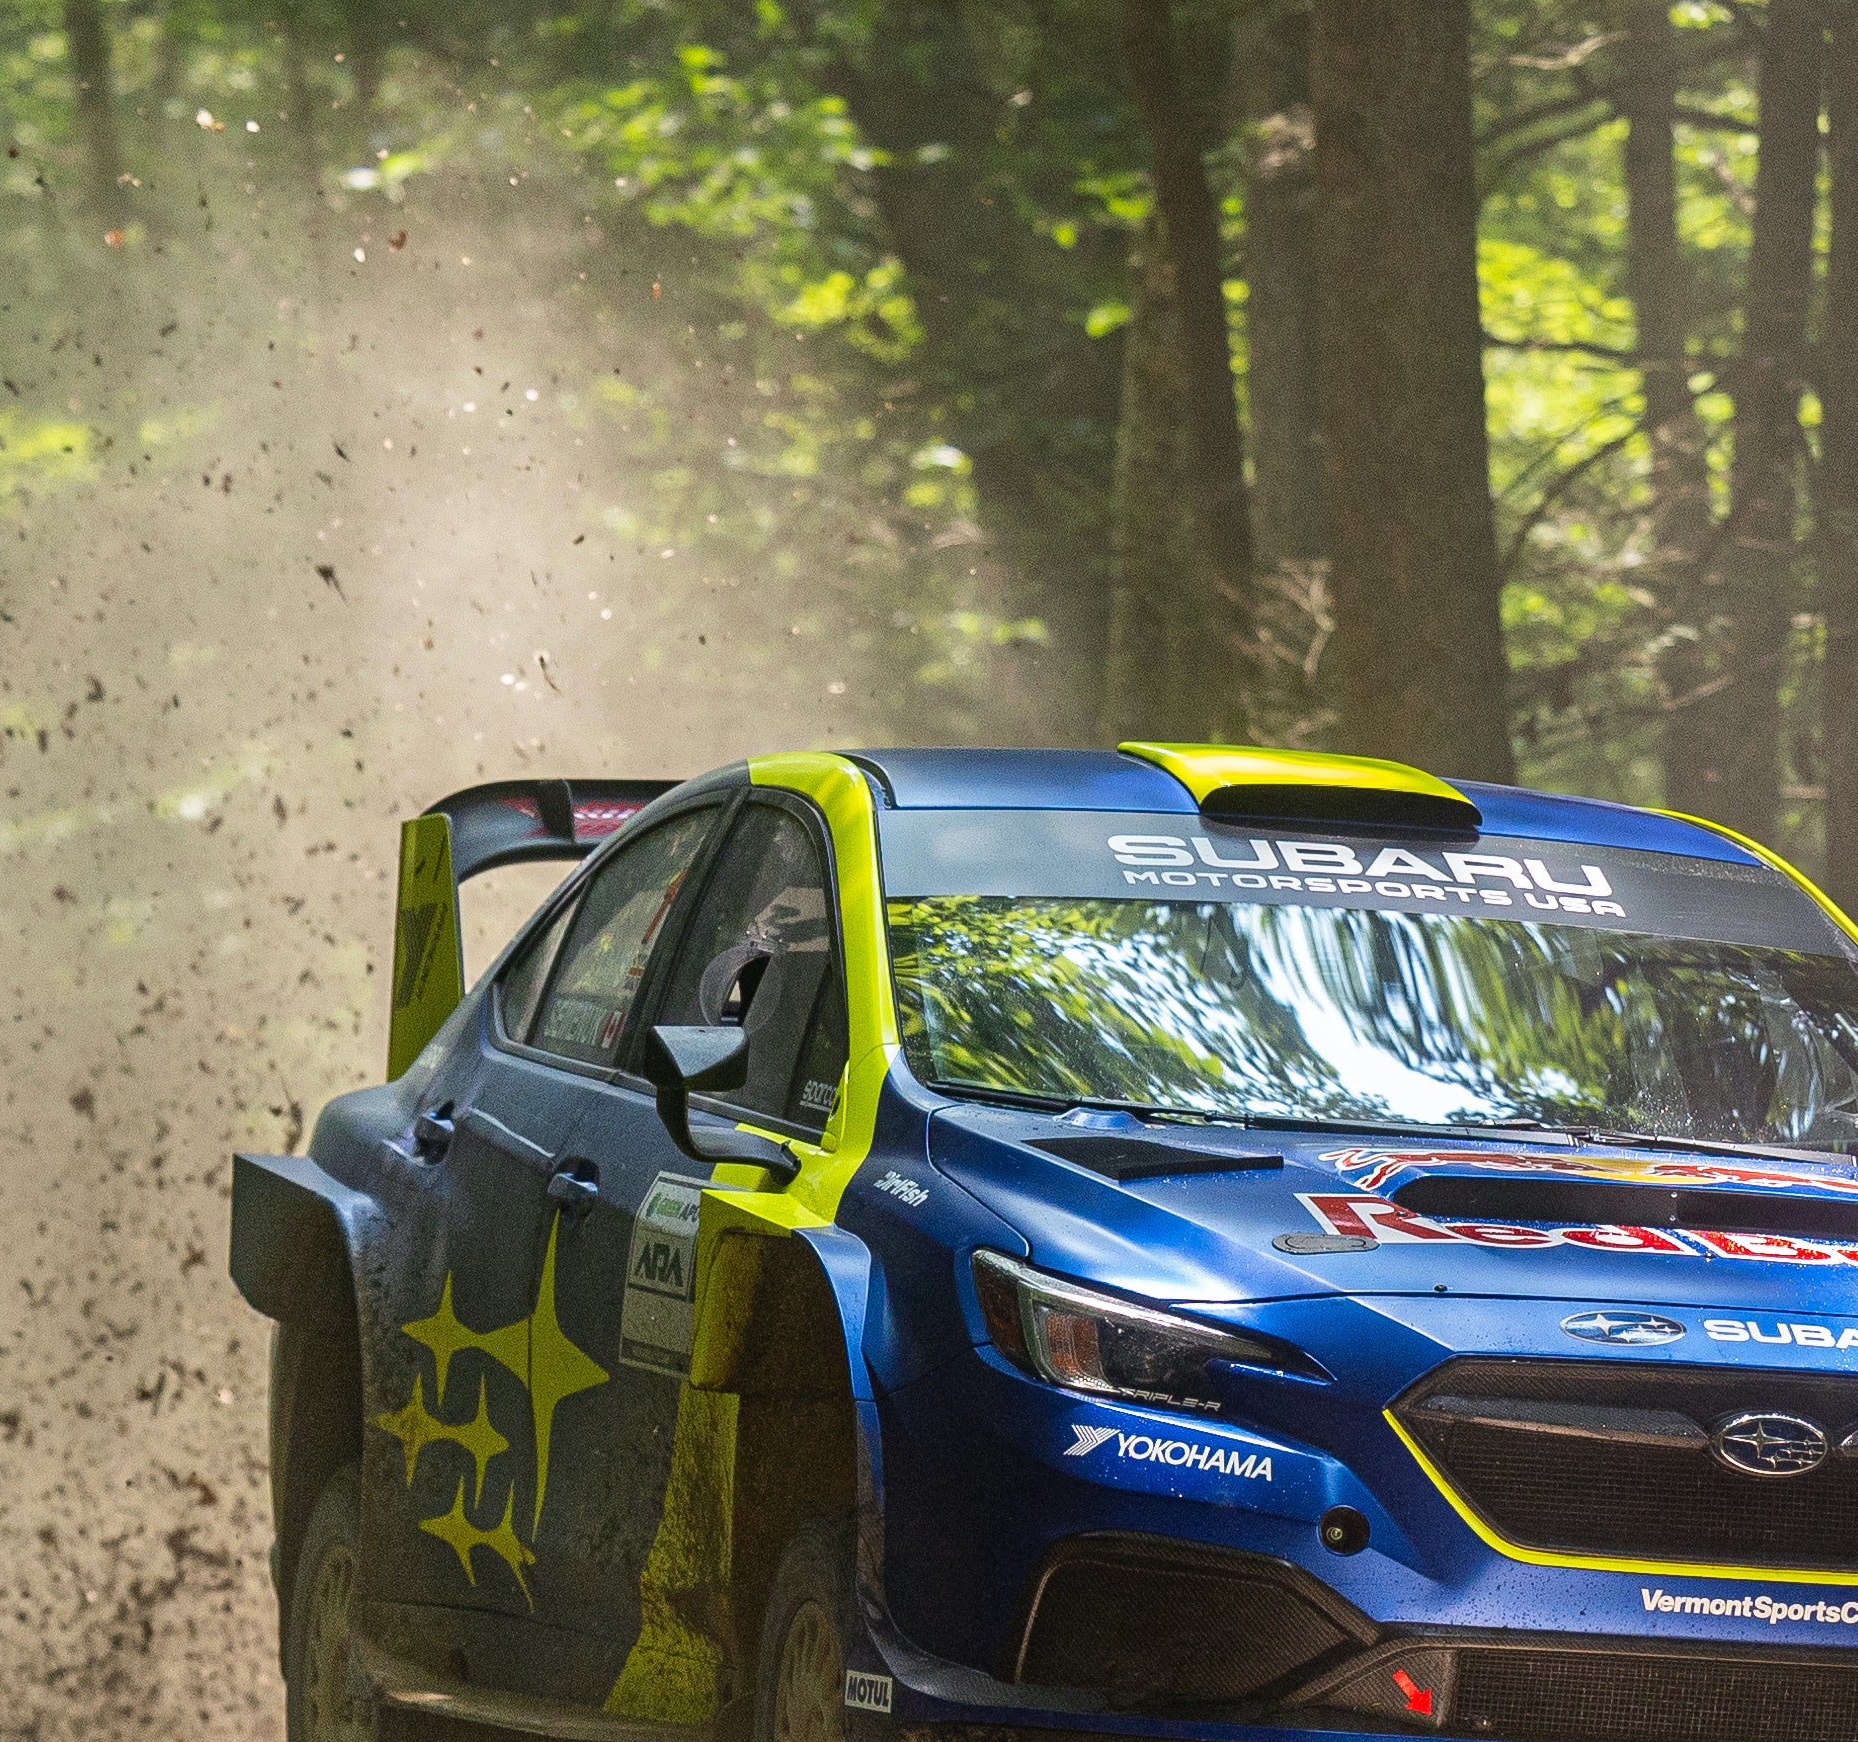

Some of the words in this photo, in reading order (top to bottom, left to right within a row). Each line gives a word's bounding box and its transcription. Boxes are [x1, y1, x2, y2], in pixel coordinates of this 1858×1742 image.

[1107, 835, 1613, 897] SUBARU
[1123, 870, 1513, 906] MOTORSPORTS
[1523, 892, 1627, 918] USA
[1117, 1433, 1273, 1482] YOKOHAMA
[846, 1675, 890, 1707] MOTUL
